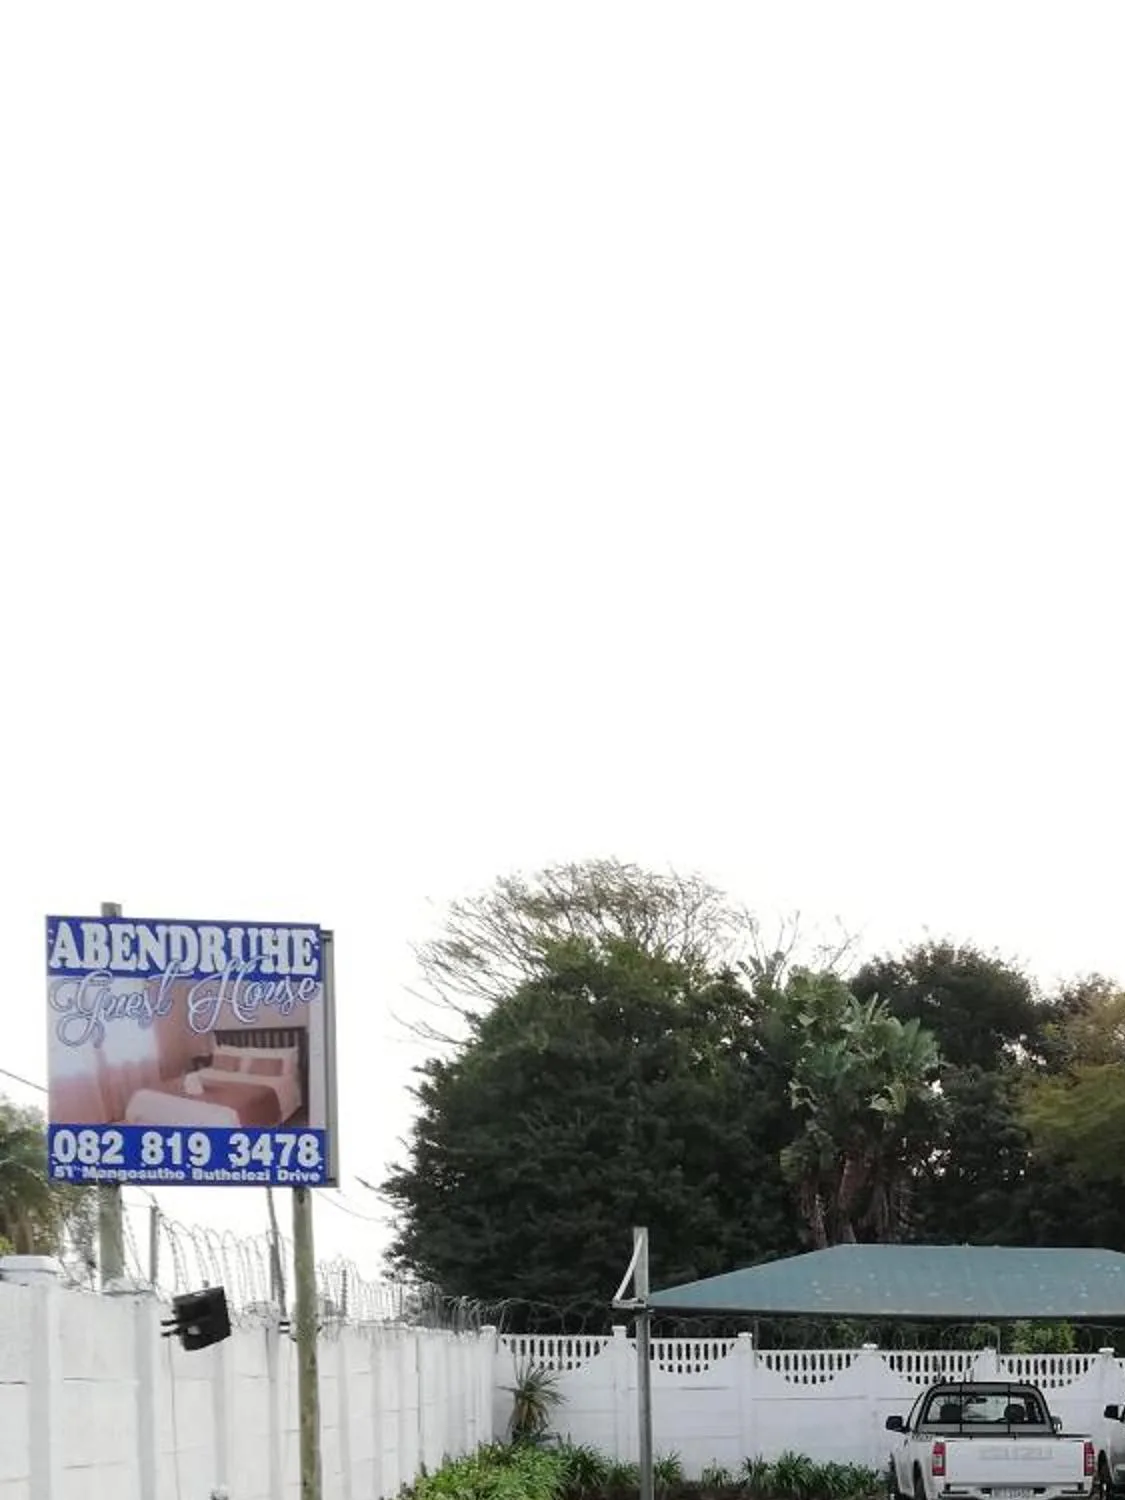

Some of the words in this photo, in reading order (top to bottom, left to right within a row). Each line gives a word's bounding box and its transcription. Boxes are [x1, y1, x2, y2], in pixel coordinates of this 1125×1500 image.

[50, 921, 317, 975] ABENDRUHE
[49, 958, 192, 1046] Guest
[188, 957, 318, 1033] House
[53, 1129, 125, 1165] 082
[141, 1131, 211, 1167] 819
[230, 1133, 320, 1168] 3478
[192, 1168, 271, 1181] Buthelezi
[278, 1169, 320, 1182] Drive
